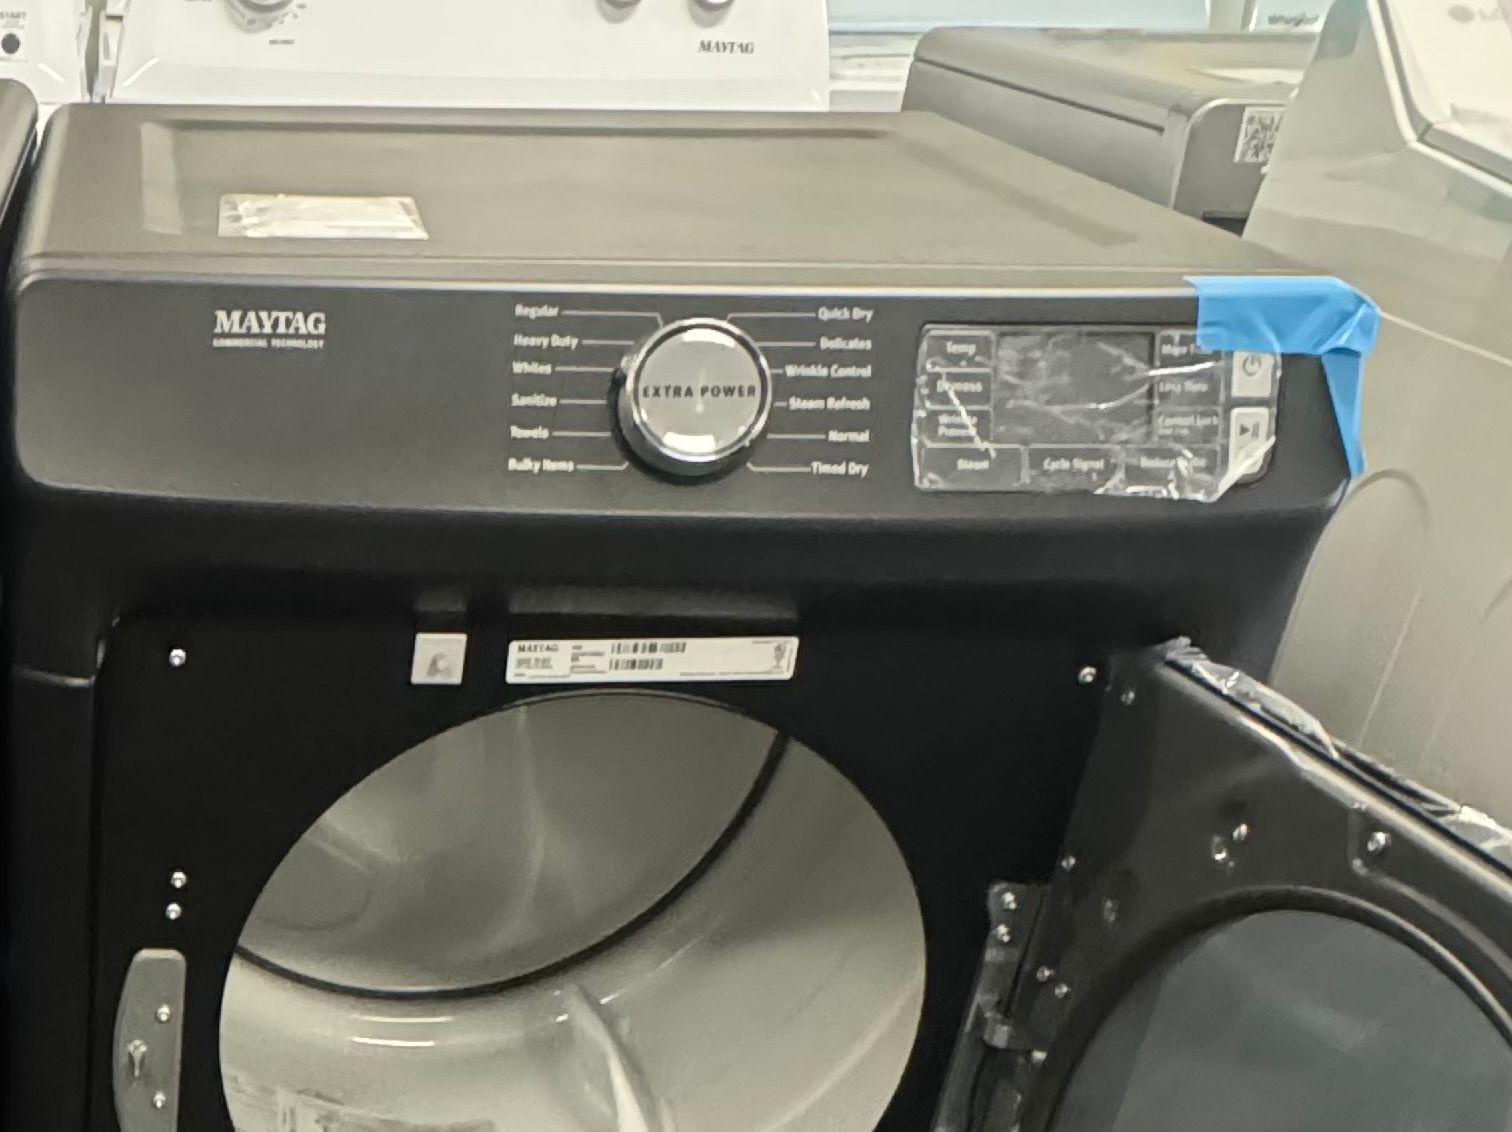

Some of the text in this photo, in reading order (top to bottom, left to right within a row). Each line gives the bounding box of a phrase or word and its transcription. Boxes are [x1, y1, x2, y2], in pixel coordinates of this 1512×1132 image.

[697, 40, 755, 54] MAYTAG
[514, 303, 559, 319] Regular
[818, 306, 874, 323] Quick Dry
[213, 309, 327, 335] MAYTAG
[513, 333, 579, 350] Heavy Duty
[820, 335, 872, 350] Delicates
[785, 364, 872, 379] Wrinkle Control
[642, 384, 757, 399] EXTRA POWER
[811, 460, 870, 479] Timed Dry
